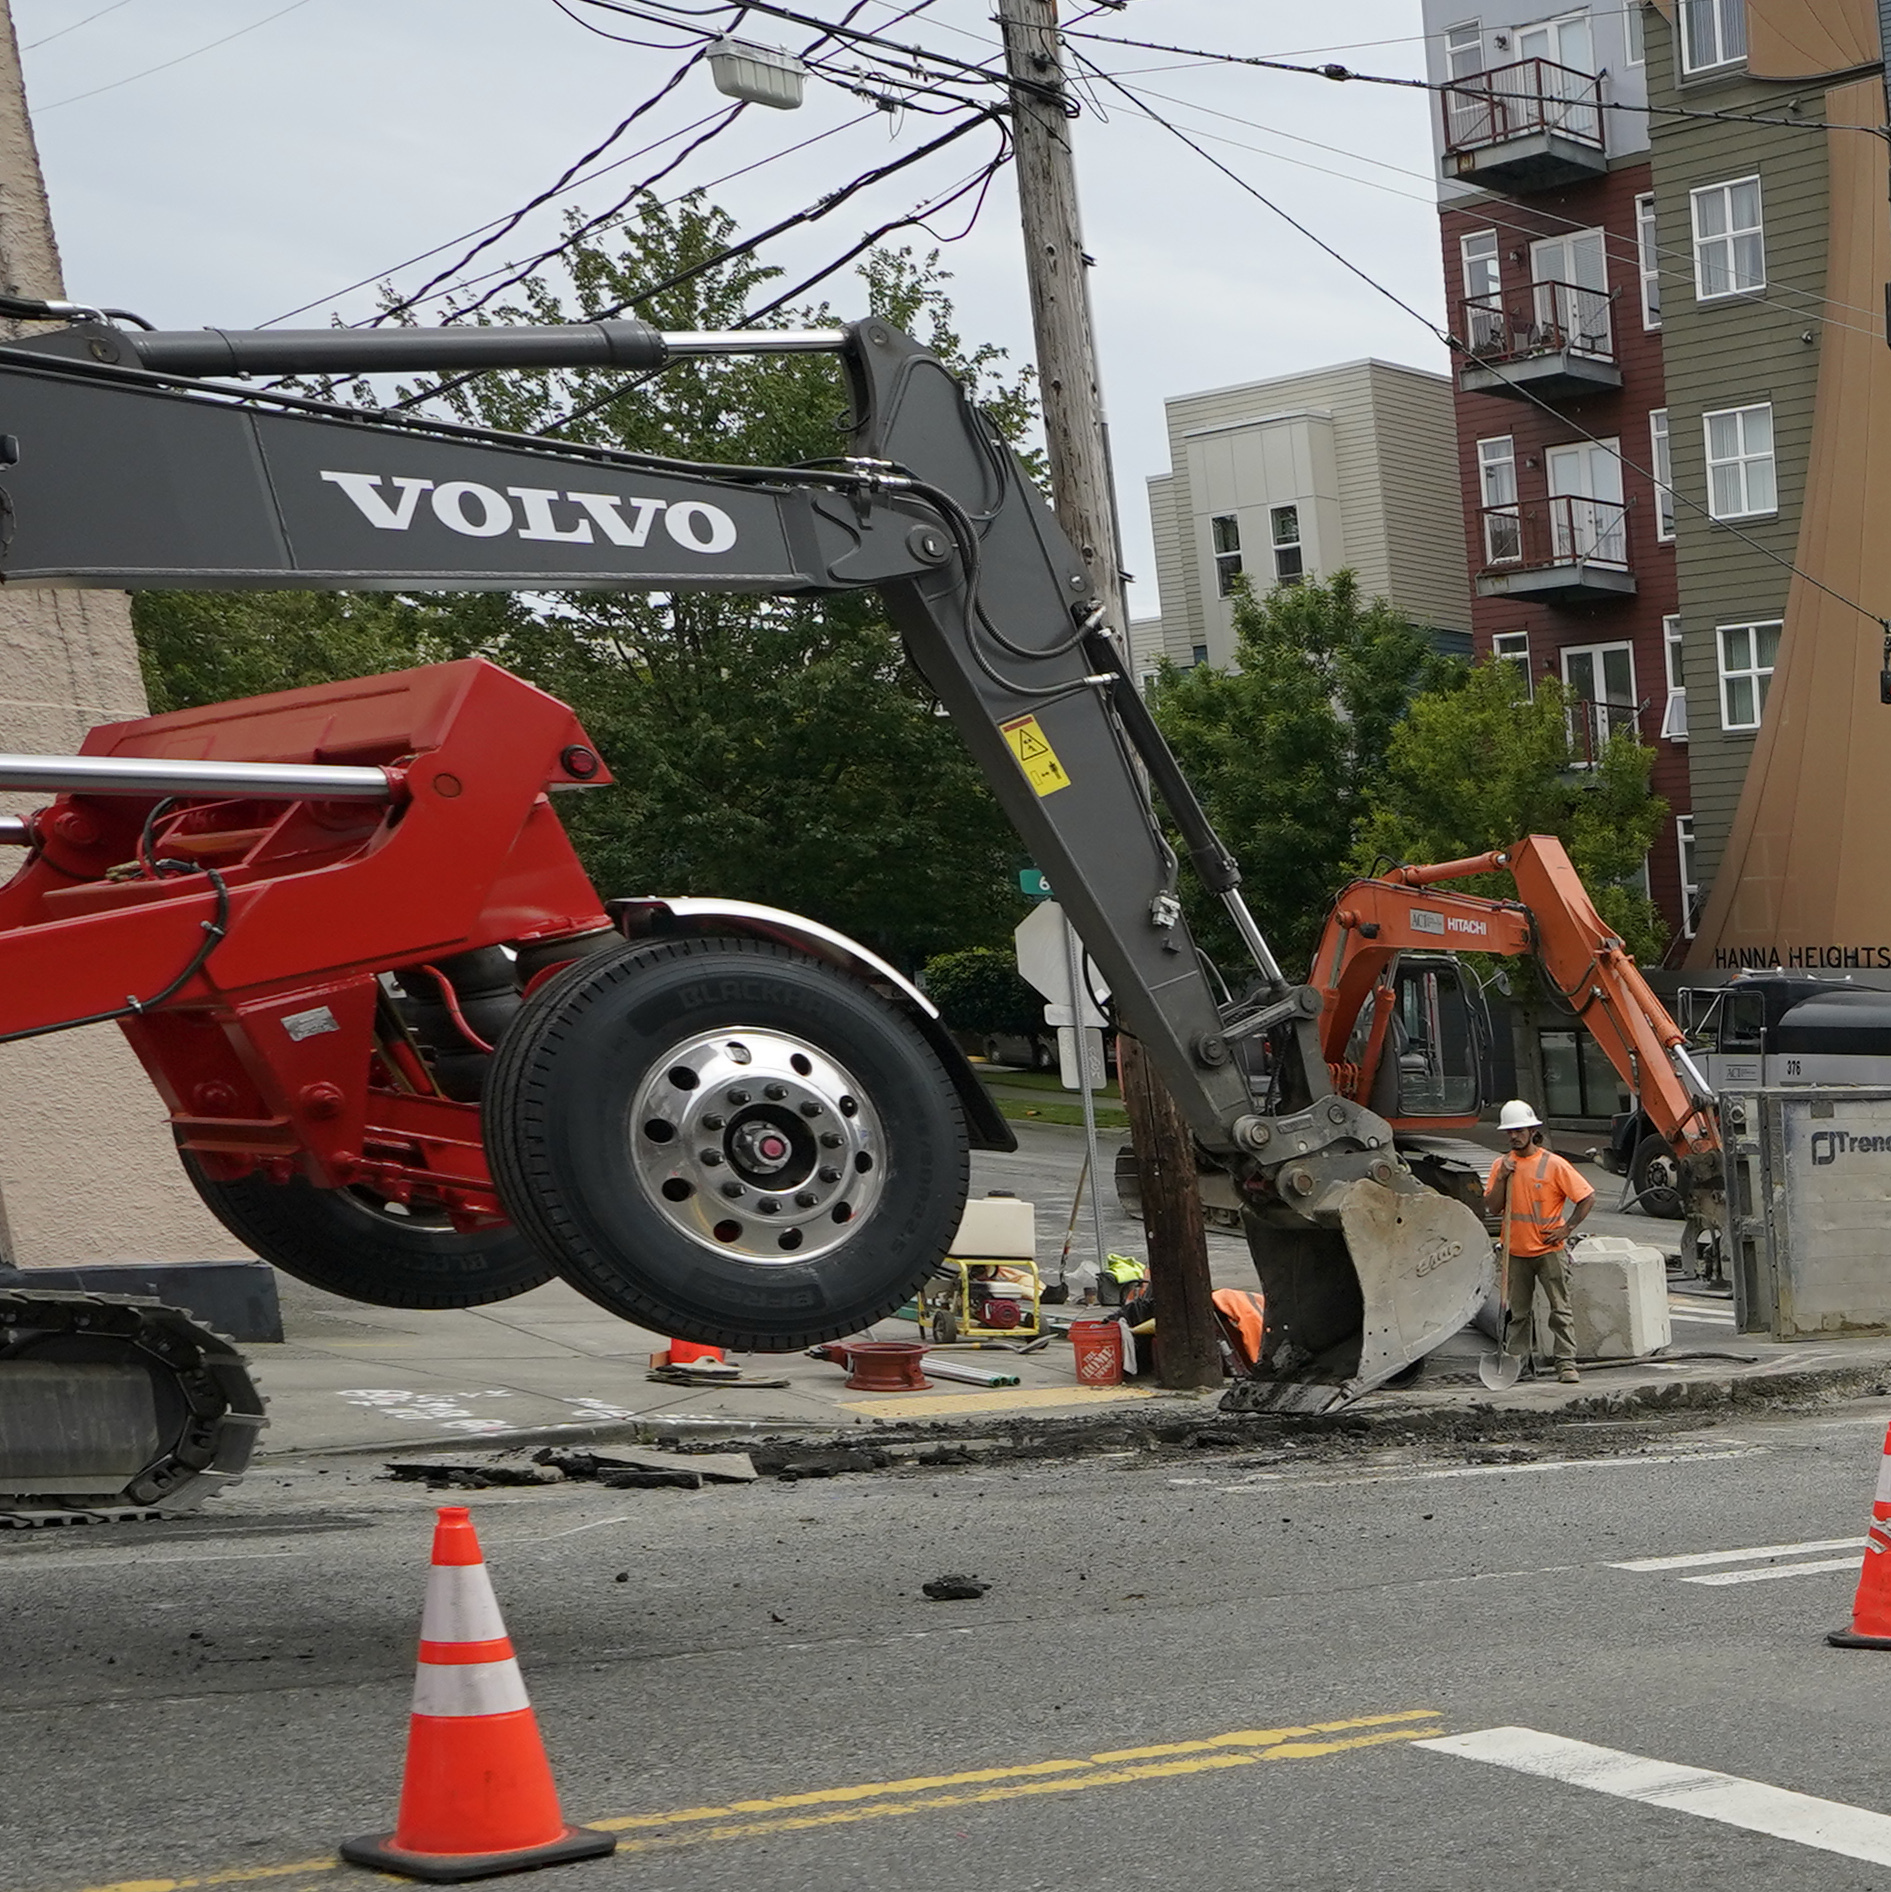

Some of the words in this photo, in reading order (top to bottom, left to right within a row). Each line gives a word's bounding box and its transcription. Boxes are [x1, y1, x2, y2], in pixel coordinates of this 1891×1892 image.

[320, 470, 738, 554] VOLVO
[1447, 917, 1487, 935] HITACHI
[1715, 947, 1781, 968] HANNA
[1789, 946, 1891, 969] HEIGHTS
